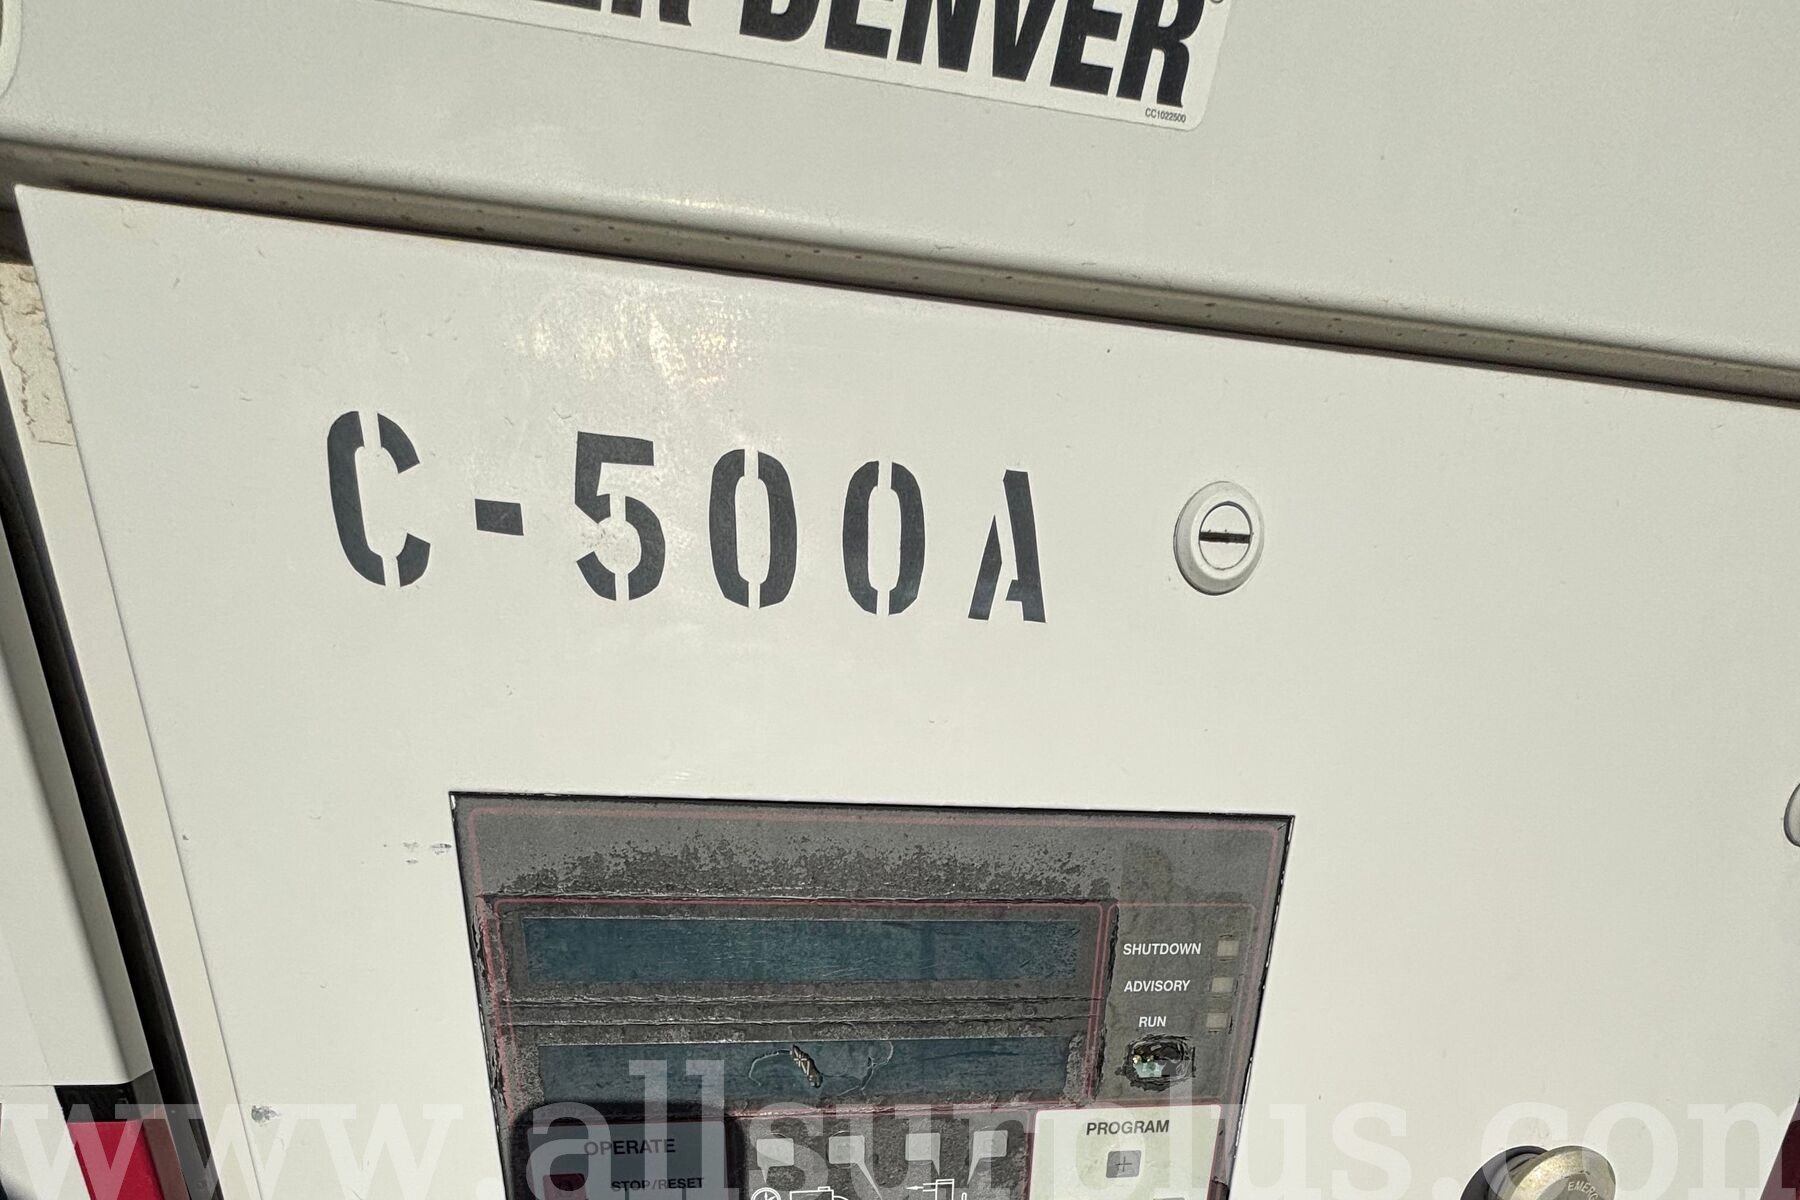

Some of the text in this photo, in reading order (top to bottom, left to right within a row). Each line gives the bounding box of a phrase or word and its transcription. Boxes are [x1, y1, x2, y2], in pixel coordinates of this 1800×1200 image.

[1123, 943, 1201, 955] SHUTDOWN
[1124, 979, 1190, 992] ADVISORY
[1138, 1016, 1167, 1027] RUN
[1086, 1120, 1170, 1136] PROGRAM
[584, 1138, 676, 1155] OPERATE
[611, 1177, 704, 1192] STOP/RESET
